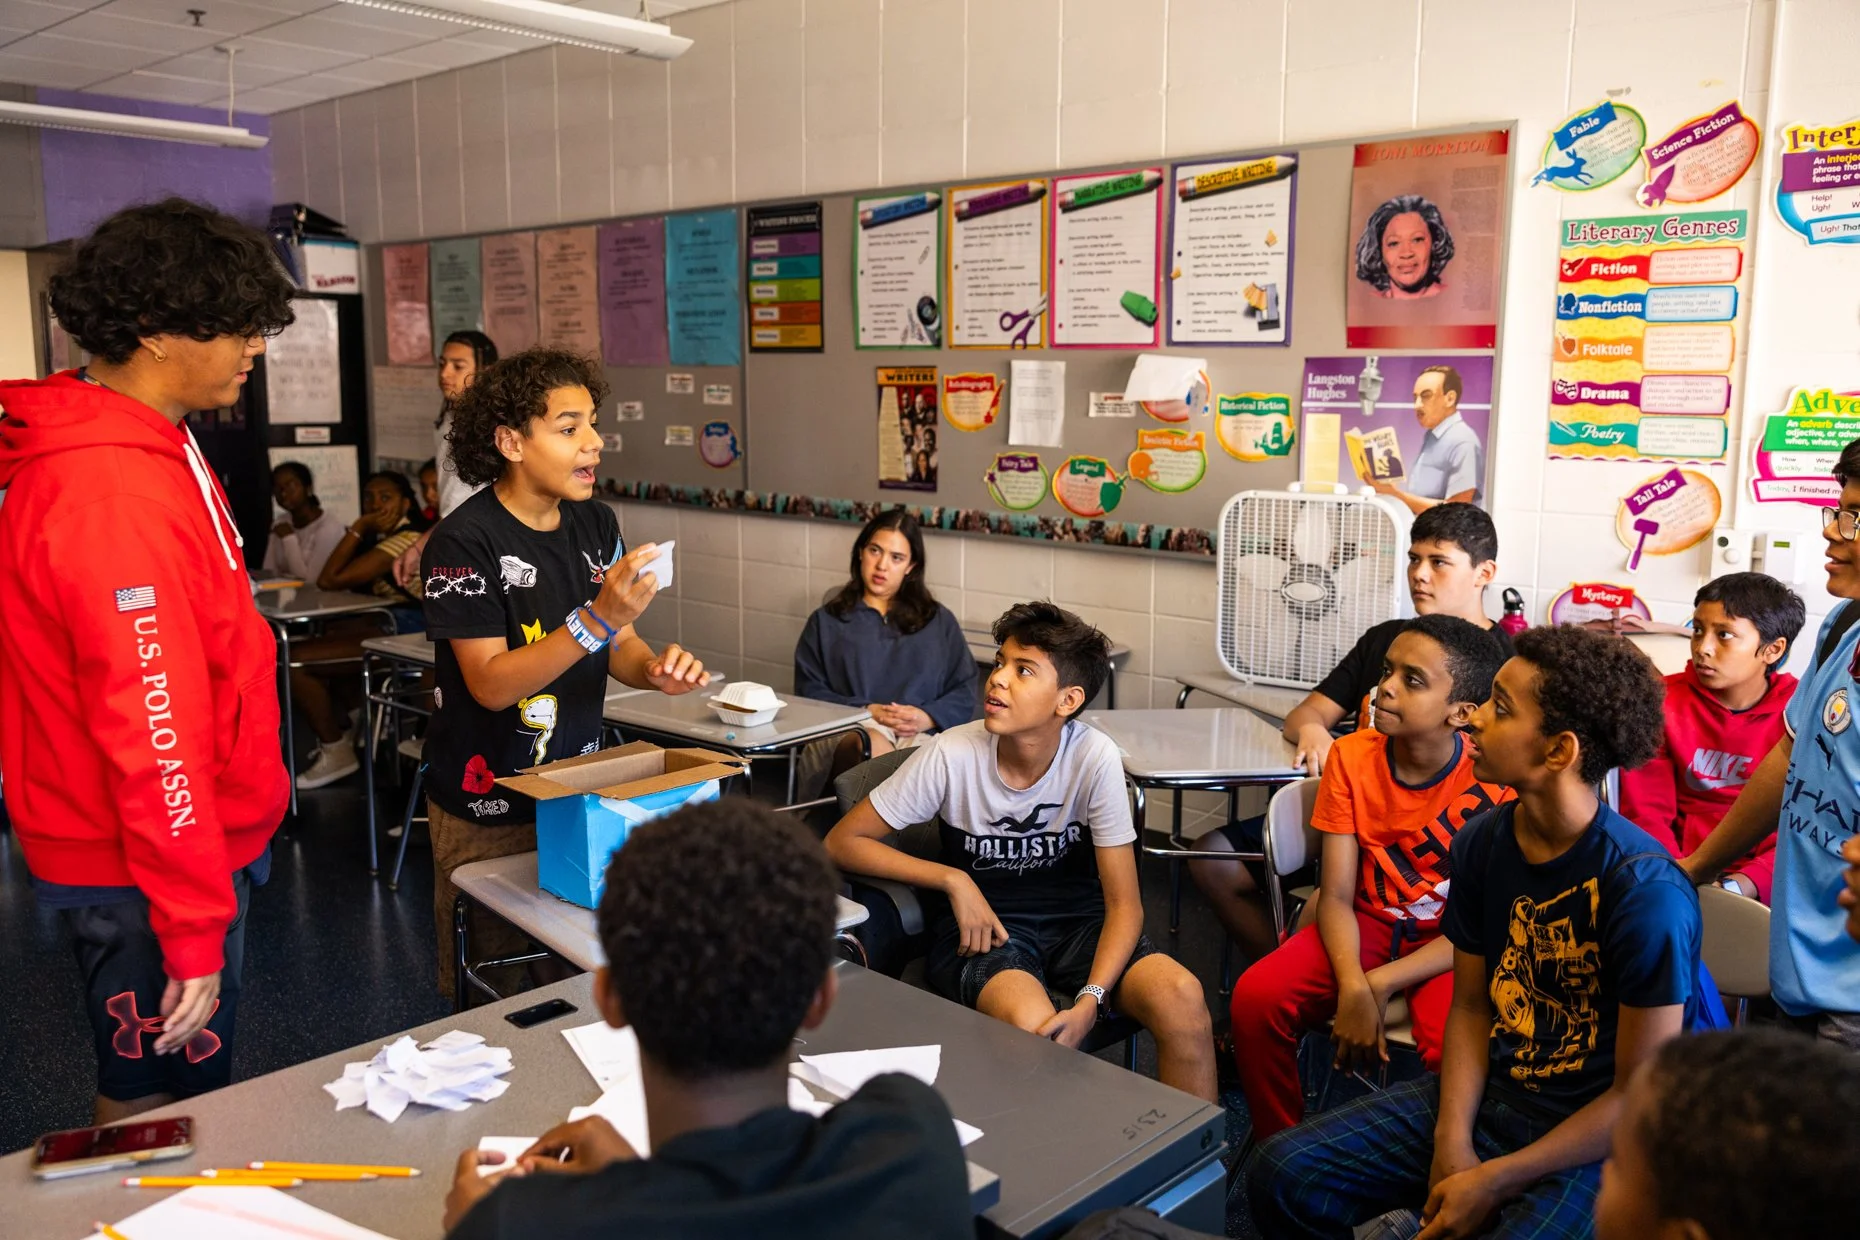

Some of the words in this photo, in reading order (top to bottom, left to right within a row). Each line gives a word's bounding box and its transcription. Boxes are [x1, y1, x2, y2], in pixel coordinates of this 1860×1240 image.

[1568, 117, 1600, 138] Fable
[1651, 135, 1693, 160] Science
[1692, 113, 1736, 140] Fiction
[1411, 138, 1492, 159] MORRISON
[1813, 157, 1825, 165] An
[1813, 166, 1842, 175] phrase
[1812, 174, 1841, 184] feeling
[1843, 173, 1852, 181] or
[1811, 194, 1832, 203] Help!
[1811, 204, 1831, 213] Ugh!
[1568, 223, 1656, 243] Literary
[1663, 217, 1737, 236] Genres
[1820, 225, 1840, 234] Ugh!
[1590, 263, 1637, 276] Fiction
[1578, 301, 1642, 314] Nonfiction
[1583, 343, 1633, 356] Folktale
[886, 373, 935, 382] WRITERS
[1308, 372, 1356, 389] Langston
[1307, 387, 1347, 401] Hughes
[1580, 387, 1629, 400] Drama
[1220, 401, 1256, 411] Historical
[1257, 401, 1286, 411] Fiction
[1786, 420, 1798, 428] An
[1799, 419, 1833, 429] adverb
[1580, 424, 1625, 444] Poetry
[1785, 429, 1825, 440] adjective,
[1785, 437, 1809, 446] when,
[1811, 438, 1838, 447] where,
[1001, 460, 1018, 470] Fairy
[1019, 460, 1034, 468] Tale
[1074, 461, 1099, 473] Legend
[1633, 488, 1654, 506] Tall
[1652, 478, 1677, 496] Tale
[1799, 485, 1830, 494] finished
[432, 567, 474, 577] FOREVER
[1581, 587, 1624, 605] Mystery
[565, 609, 603, 653] BELIEV
[134, 613, 162, 668] U.S.
[142, 671, 178, 751] POLO
[1692, 748, 1754, 783] NIKE
[157, 757, 197, 838] ASSN.
[467, 798, 509, 817] TIRED
[964, 825, 1082, 859] HOLLISTER
[972, 847, 1069, 876] California
